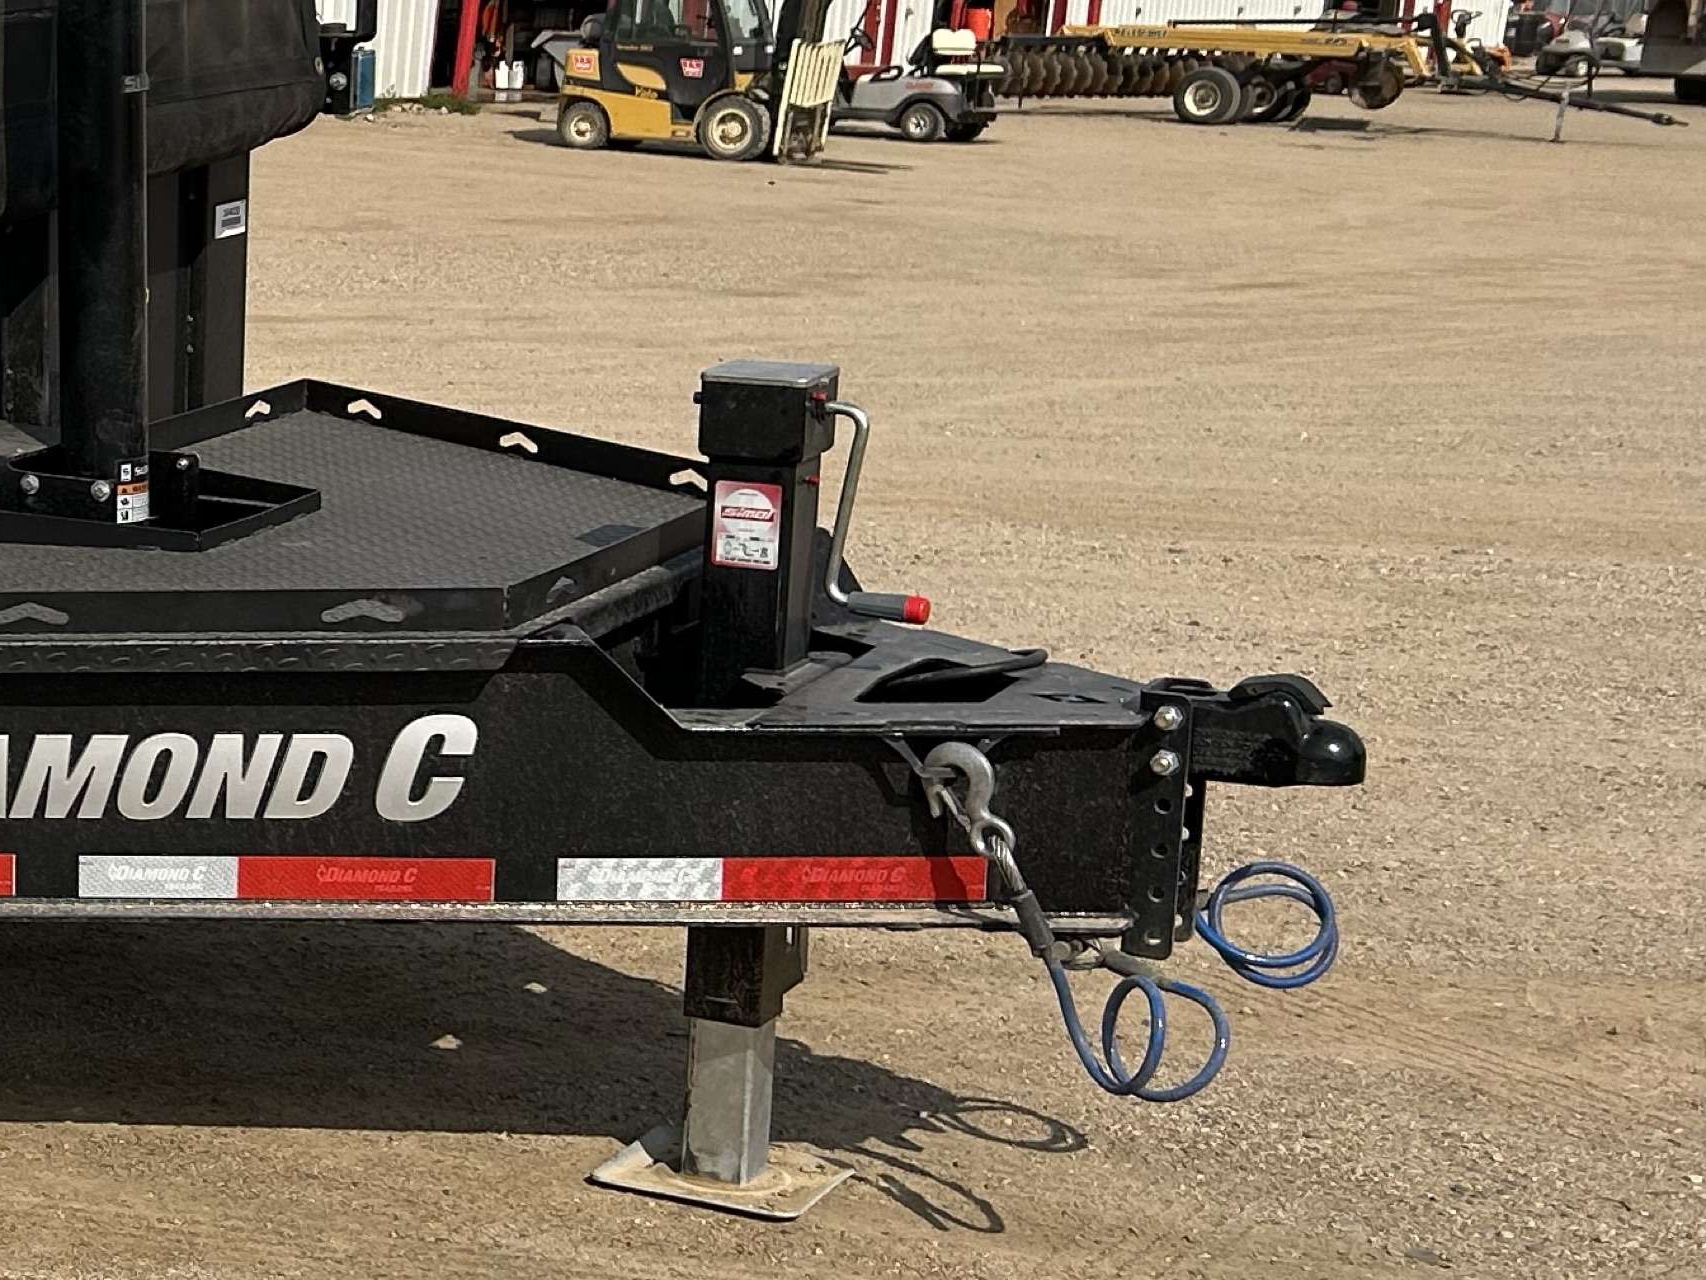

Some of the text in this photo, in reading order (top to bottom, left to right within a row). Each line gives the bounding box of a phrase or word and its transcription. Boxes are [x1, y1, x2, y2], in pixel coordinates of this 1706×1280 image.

[375, 714, 478, 822] C
[117, 865, 190, 881] DIAMOND
[325, 866, 417, 883] DIAMOND C
[809, 866, 888, 883] DIAMOND
